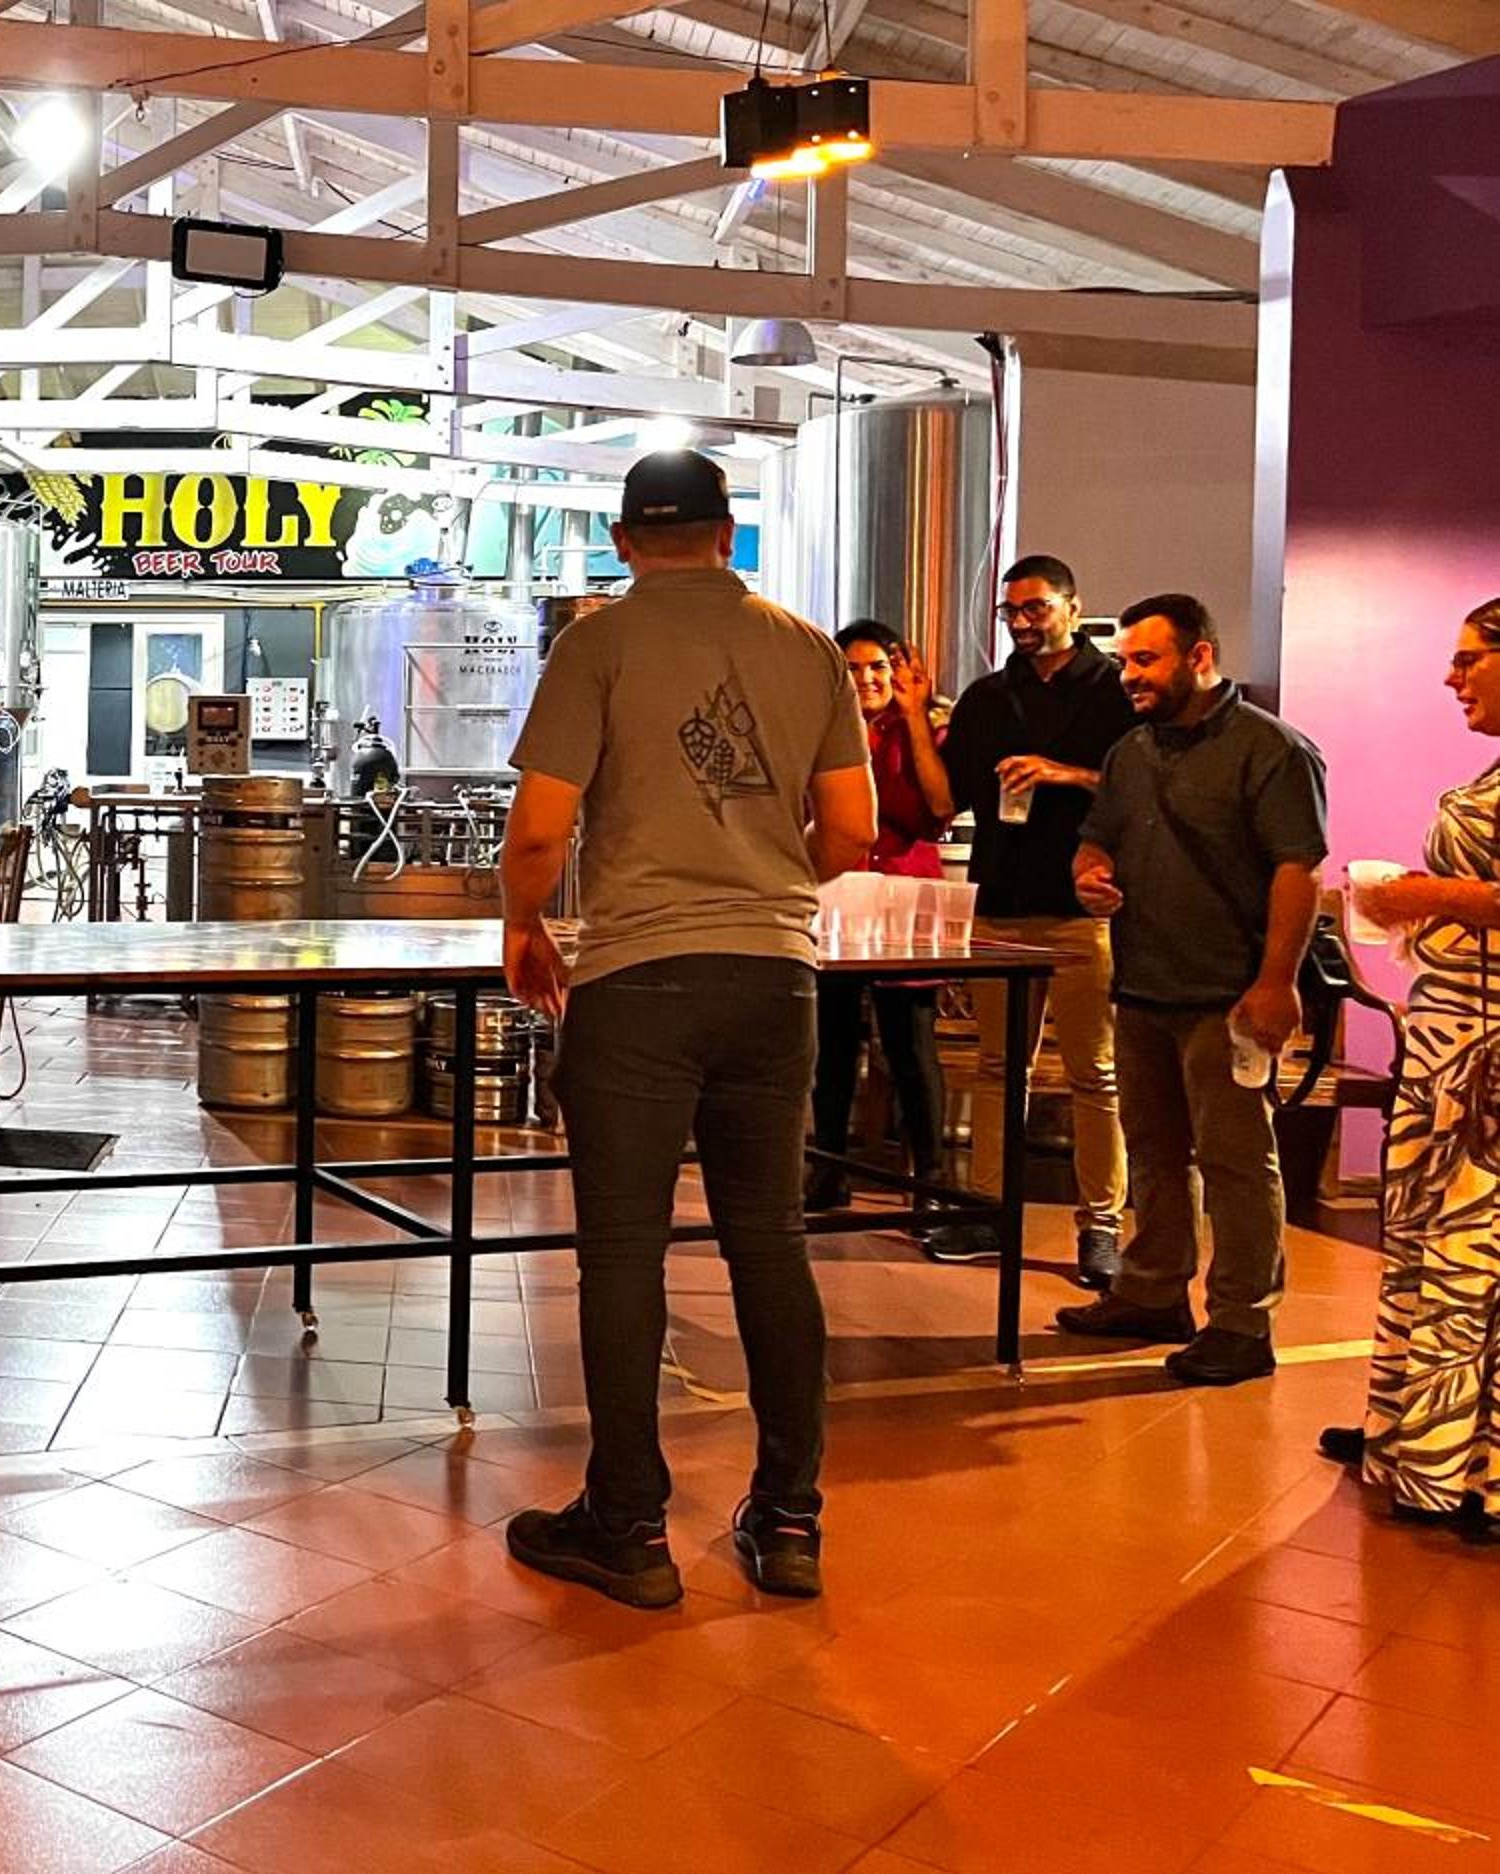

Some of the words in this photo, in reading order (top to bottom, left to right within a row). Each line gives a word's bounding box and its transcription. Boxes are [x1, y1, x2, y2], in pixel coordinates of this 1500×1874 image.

[98, 472, 342, 549] HOLY
[132, 551, 204, 577] BEER
[210, 550, 282, 575] TOUR
[62, 580, 127, 598] MALTERIA
